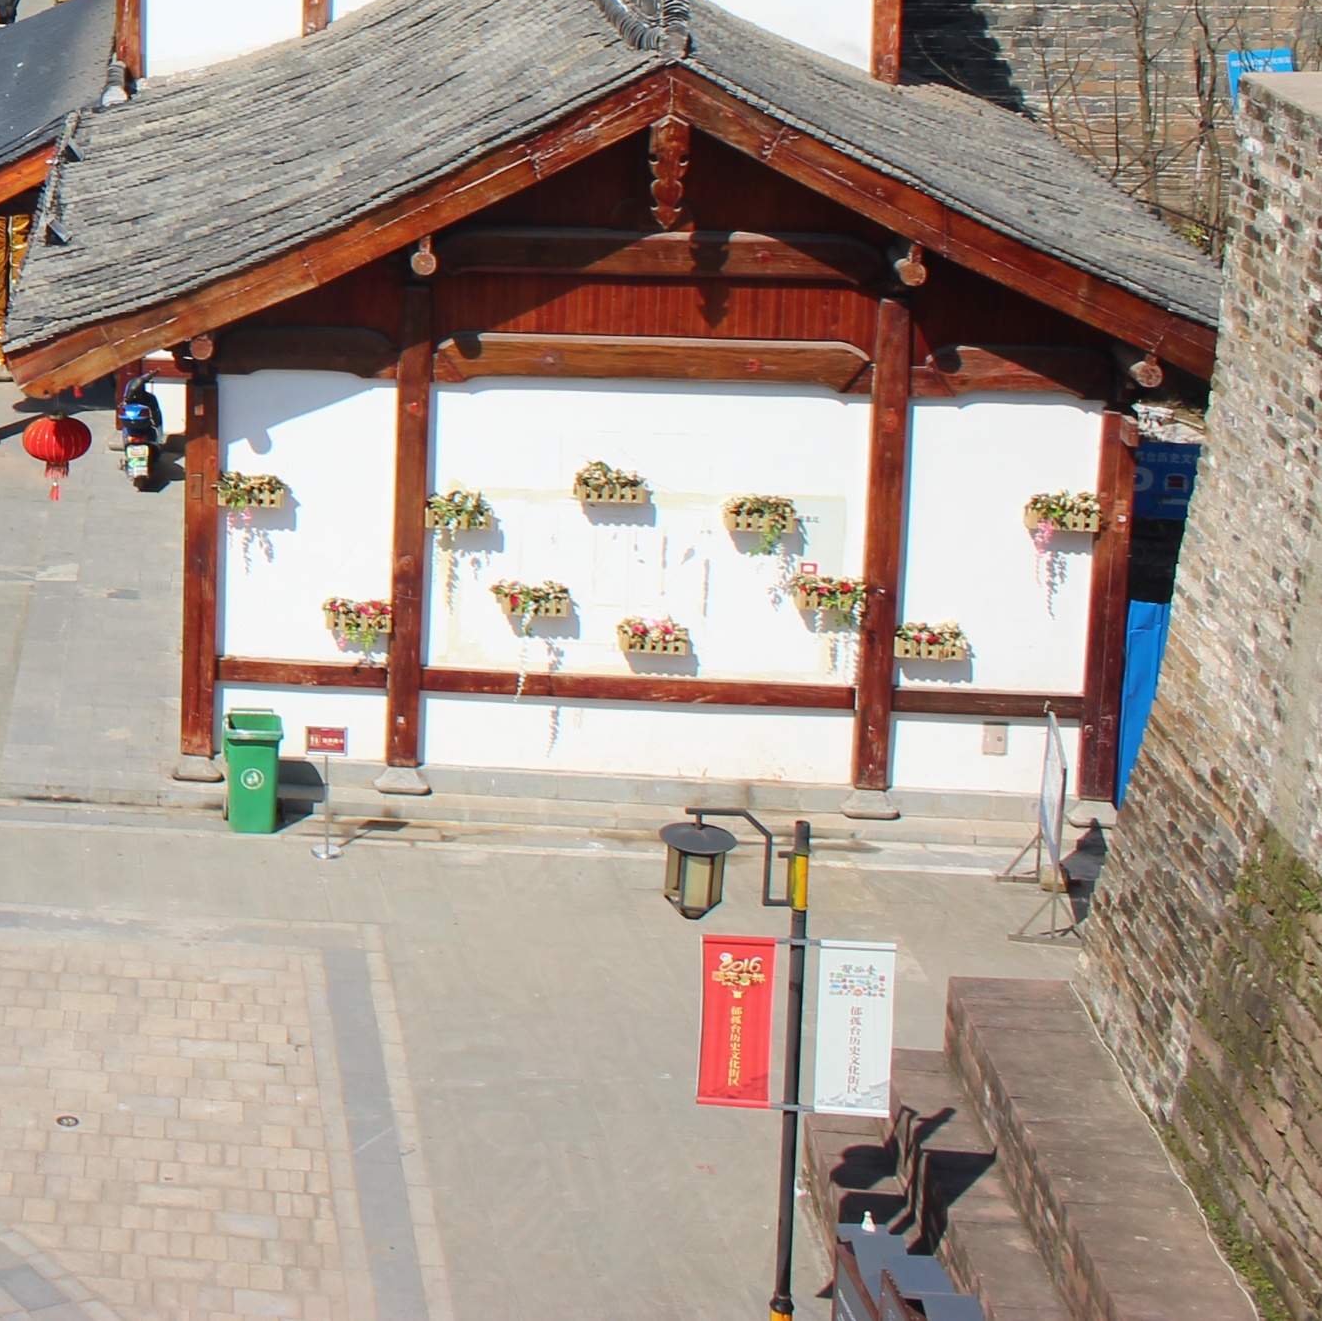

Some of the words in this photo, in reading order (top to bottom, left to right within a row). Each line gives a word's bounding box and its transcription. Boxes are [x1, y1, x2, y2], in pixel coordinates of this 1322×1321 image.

[719, 952, 763, 973] 2016
[727, 1005, 743, 1087] 郁孤台历史文化街区
[847, 1005, 864, 1095] 郁孤台历史文化街区
